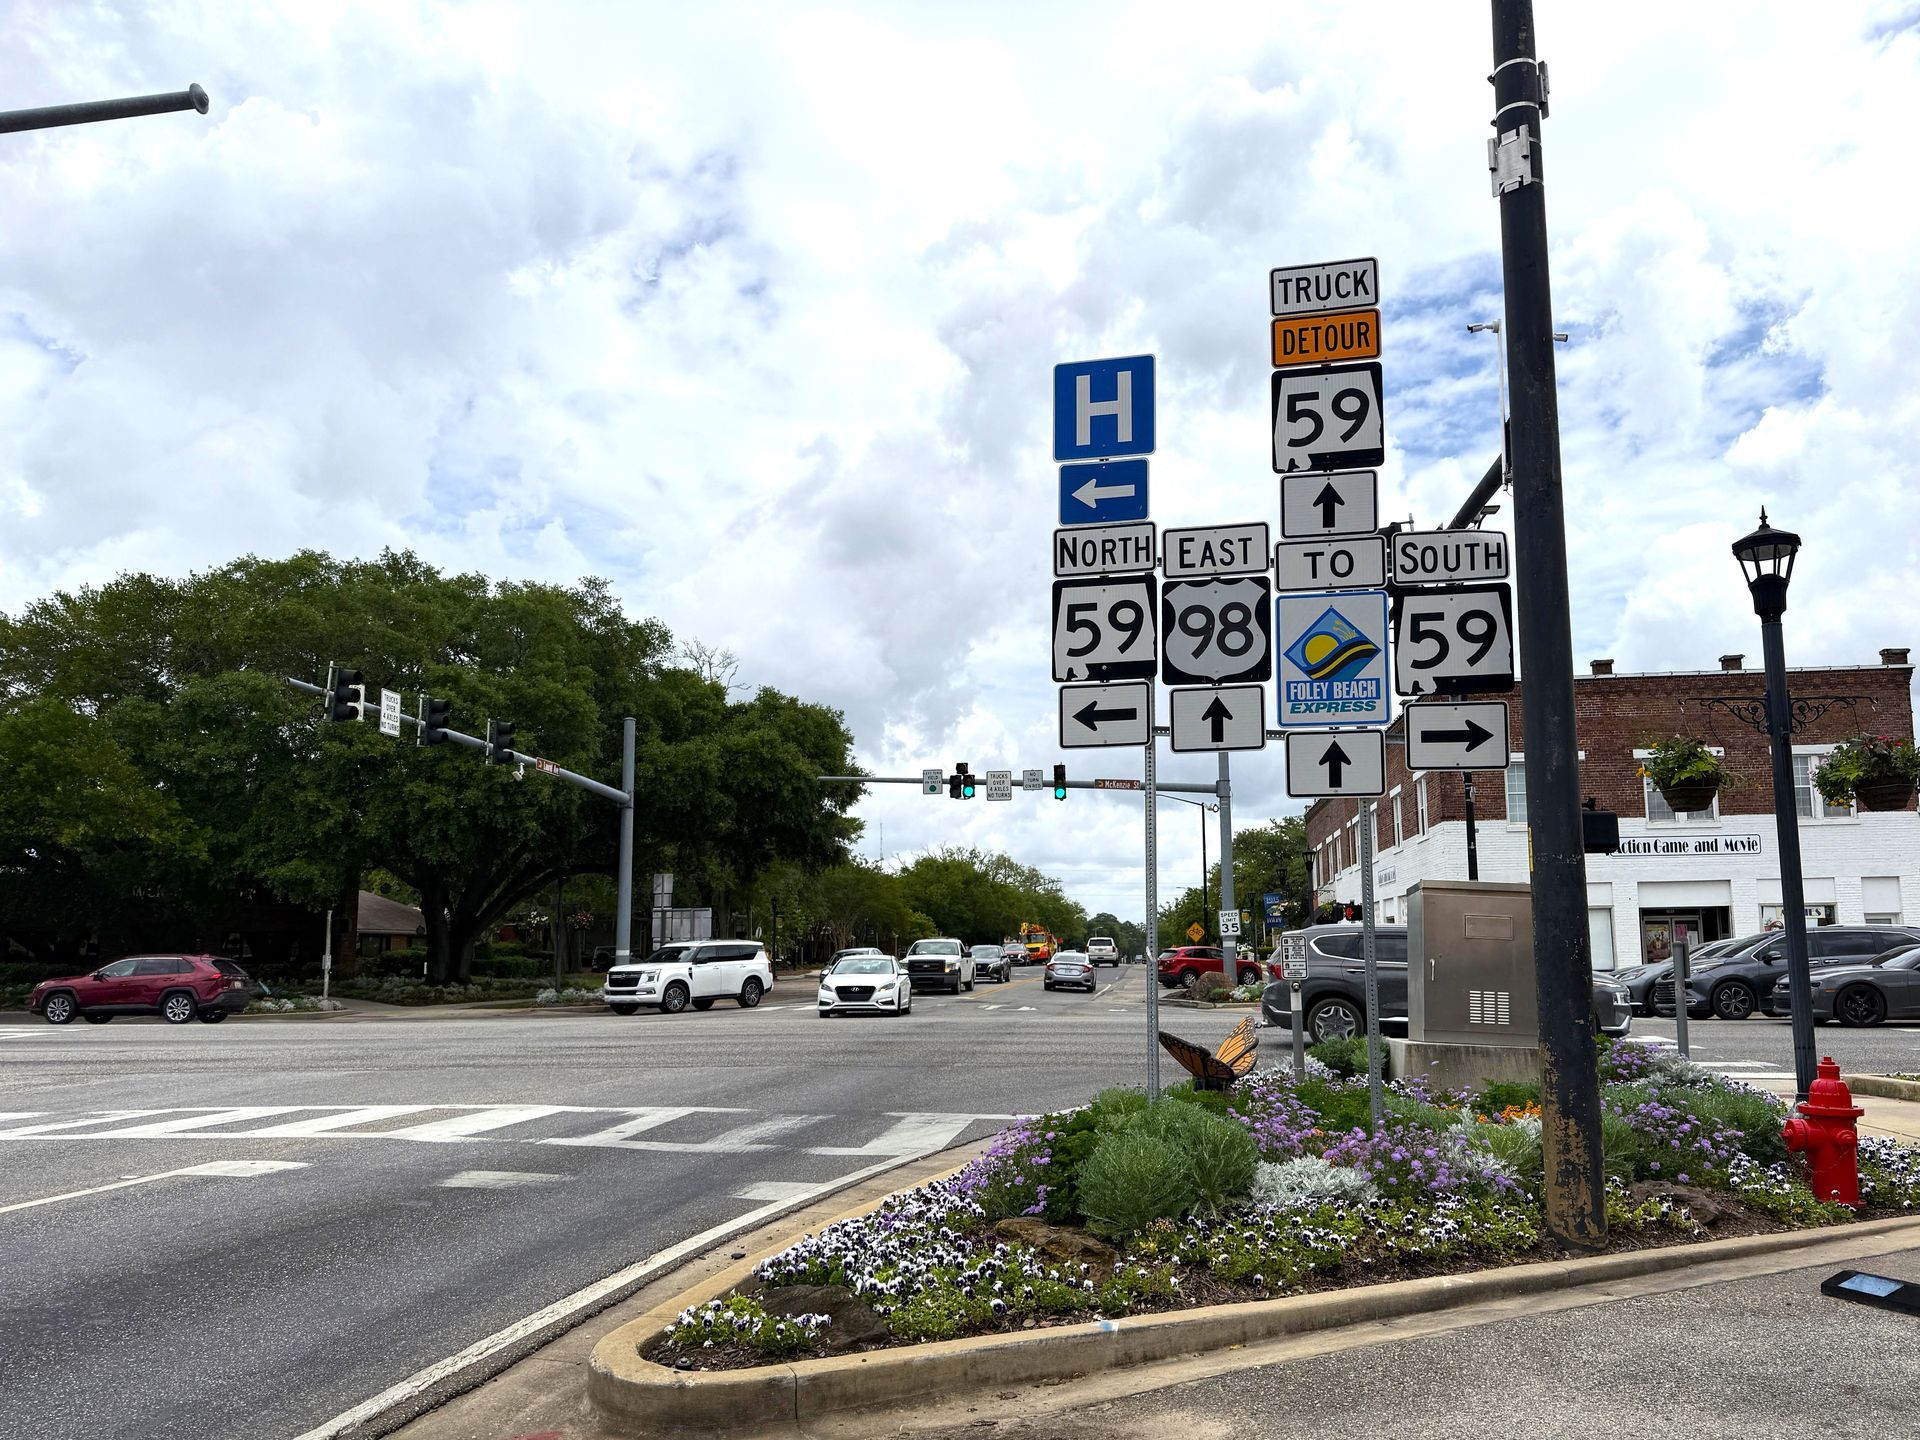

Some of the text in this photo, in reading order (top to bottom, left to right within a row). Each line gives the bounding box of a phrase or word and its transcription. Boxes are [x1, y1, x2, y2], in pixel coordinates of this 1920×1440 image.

[1279, 269, 1370, 305] TRUCK
[1282, 322, 1371, 356] DETOUR
[1075, 371, 1133, 447] H
[1286, 387, 1370, 448] 59
[1059, 536, 1151, 568] NORTH
[1179, 537, 1253, 569] EAST
[1303, 549, 1355, 580] TO
[1400, 541, 1502, 575] SOUTH
[1066, 599, 1145, 658] 59
[1178, 601, 1254, 660] 98
[1409, 609, 1498, 670] 59
[1290, 680, 1376, 700] FOLEY BEACH
[1290, 700, 1377, 714] EXPRESS
[1104, 781, 1130, 789] McKenzie
[1615, 837, 1758, 854] ction Game and Movie
[1221, 923, 1239, 933] 35
